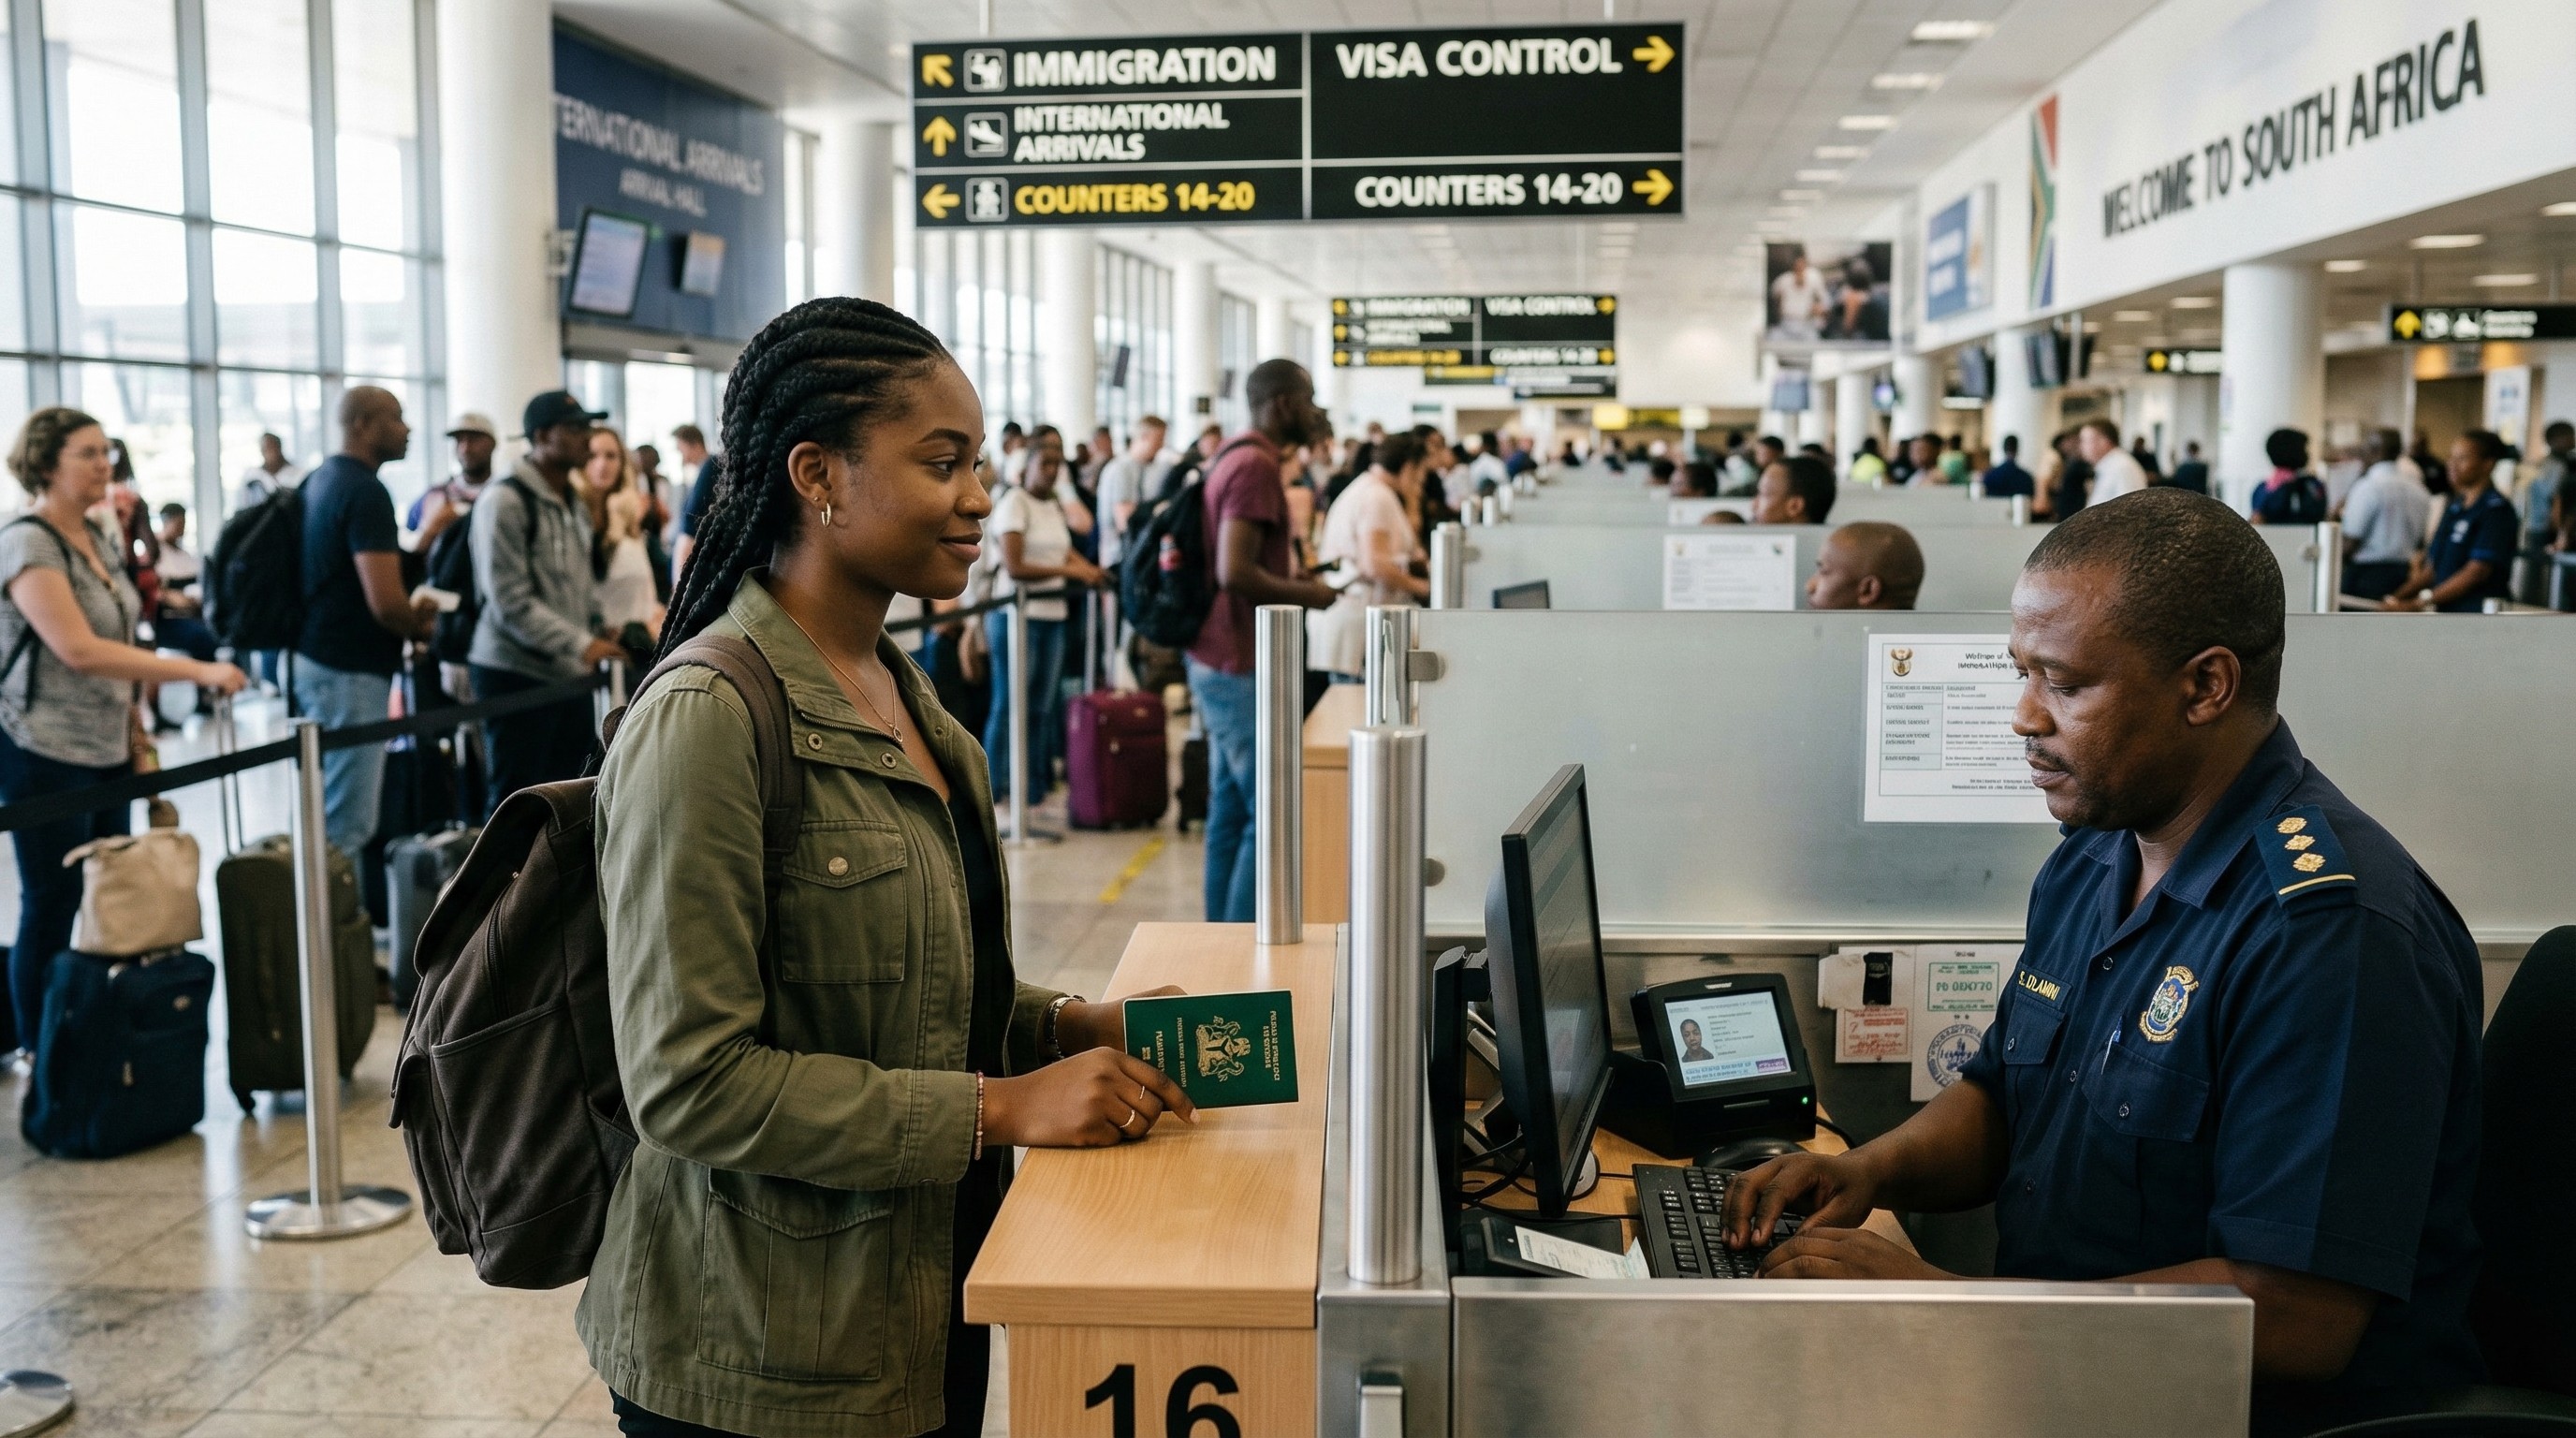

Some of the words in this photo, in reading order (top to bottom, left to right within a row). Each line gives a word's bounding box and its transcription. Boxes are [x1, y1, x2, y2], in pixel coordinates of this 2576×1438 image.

[1014, 47, 1276, 87] IMMIGRATION
[1336, 41, 1427, 79] VISA
[1436, 37, 1622, 77] CONTROL
[1014, 102, 1230, 133] INTERNATIONAL
[2103, 154, 2193, 238] WELCOME
[2204, 137, 2232, 198] TO
[2242, 86, 2335, 188] SOUTH
[2347, 19, 2485, 146] AFRICA
[1014, 133, 1146, 163] ARRIVALS
[1015, 183, 1168, 215] COUNTERS
[1176, 181, 1255, 212] 14-20
[1355, 173, 1526, 208] COUNTERS
[1533, 171, 1623, 205] 14-20
[1085, 1363, 1242, 1438] 16
